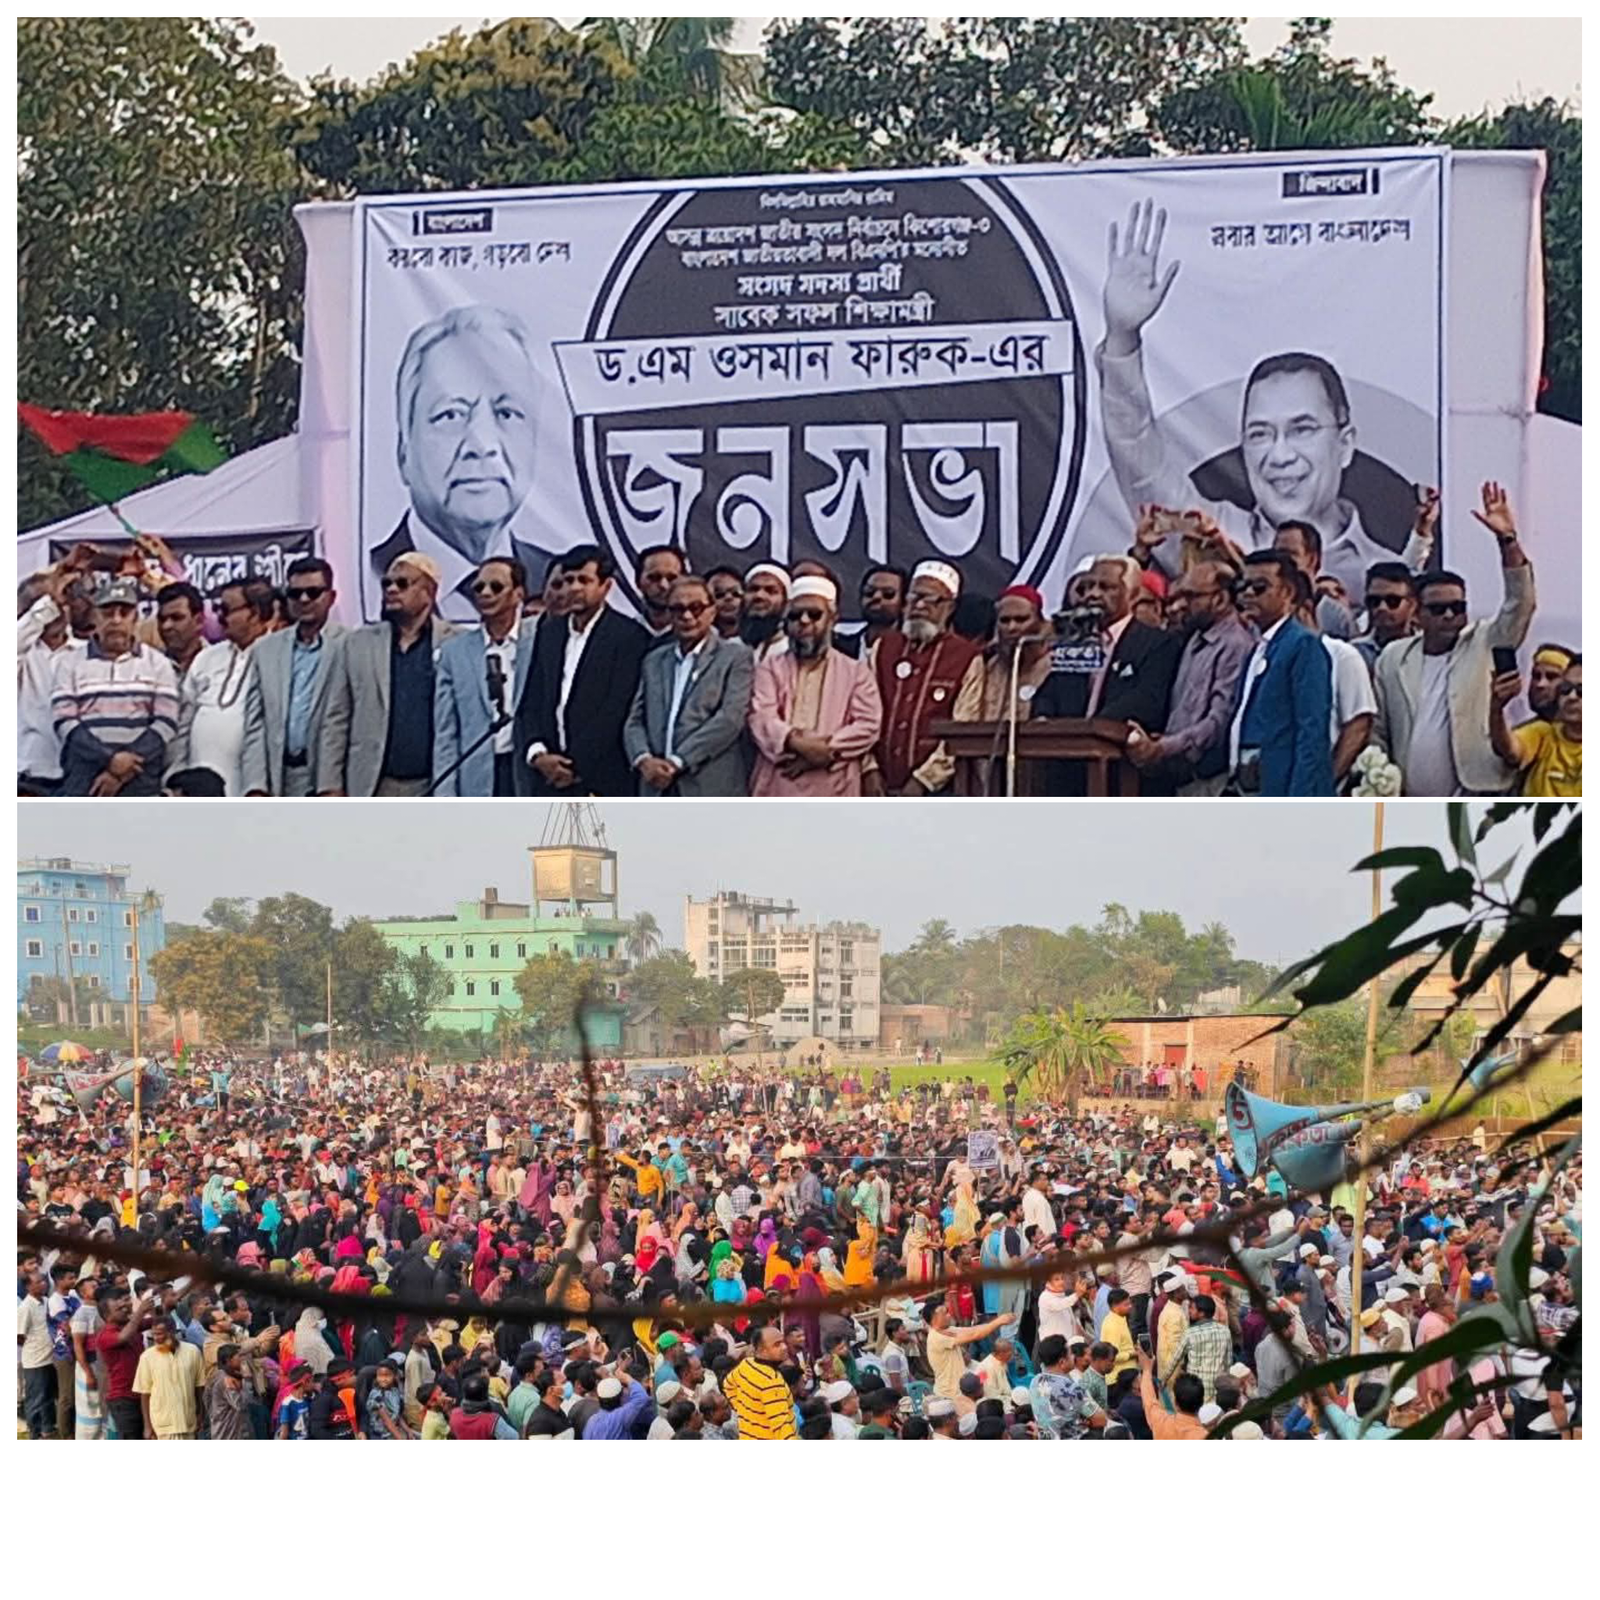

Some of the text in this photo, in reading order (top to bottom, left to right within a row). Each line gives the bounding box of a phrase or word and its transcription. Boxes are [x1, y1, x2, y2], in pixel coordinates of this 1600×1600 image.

[1318, 218, 1411, 243] বাংলাদেশ
[798, 272, 853, 295] সদস্য
[855, 262, 903, 292] প্রার্থী
[713, 290, 936, 328] সাবেক সফল শিক্ষামন্ত্রী
[594, 333, 1050, 386] ড.এম ওসমান ফারুক-এর
[606, 420, 1020, 574] জনসভা
